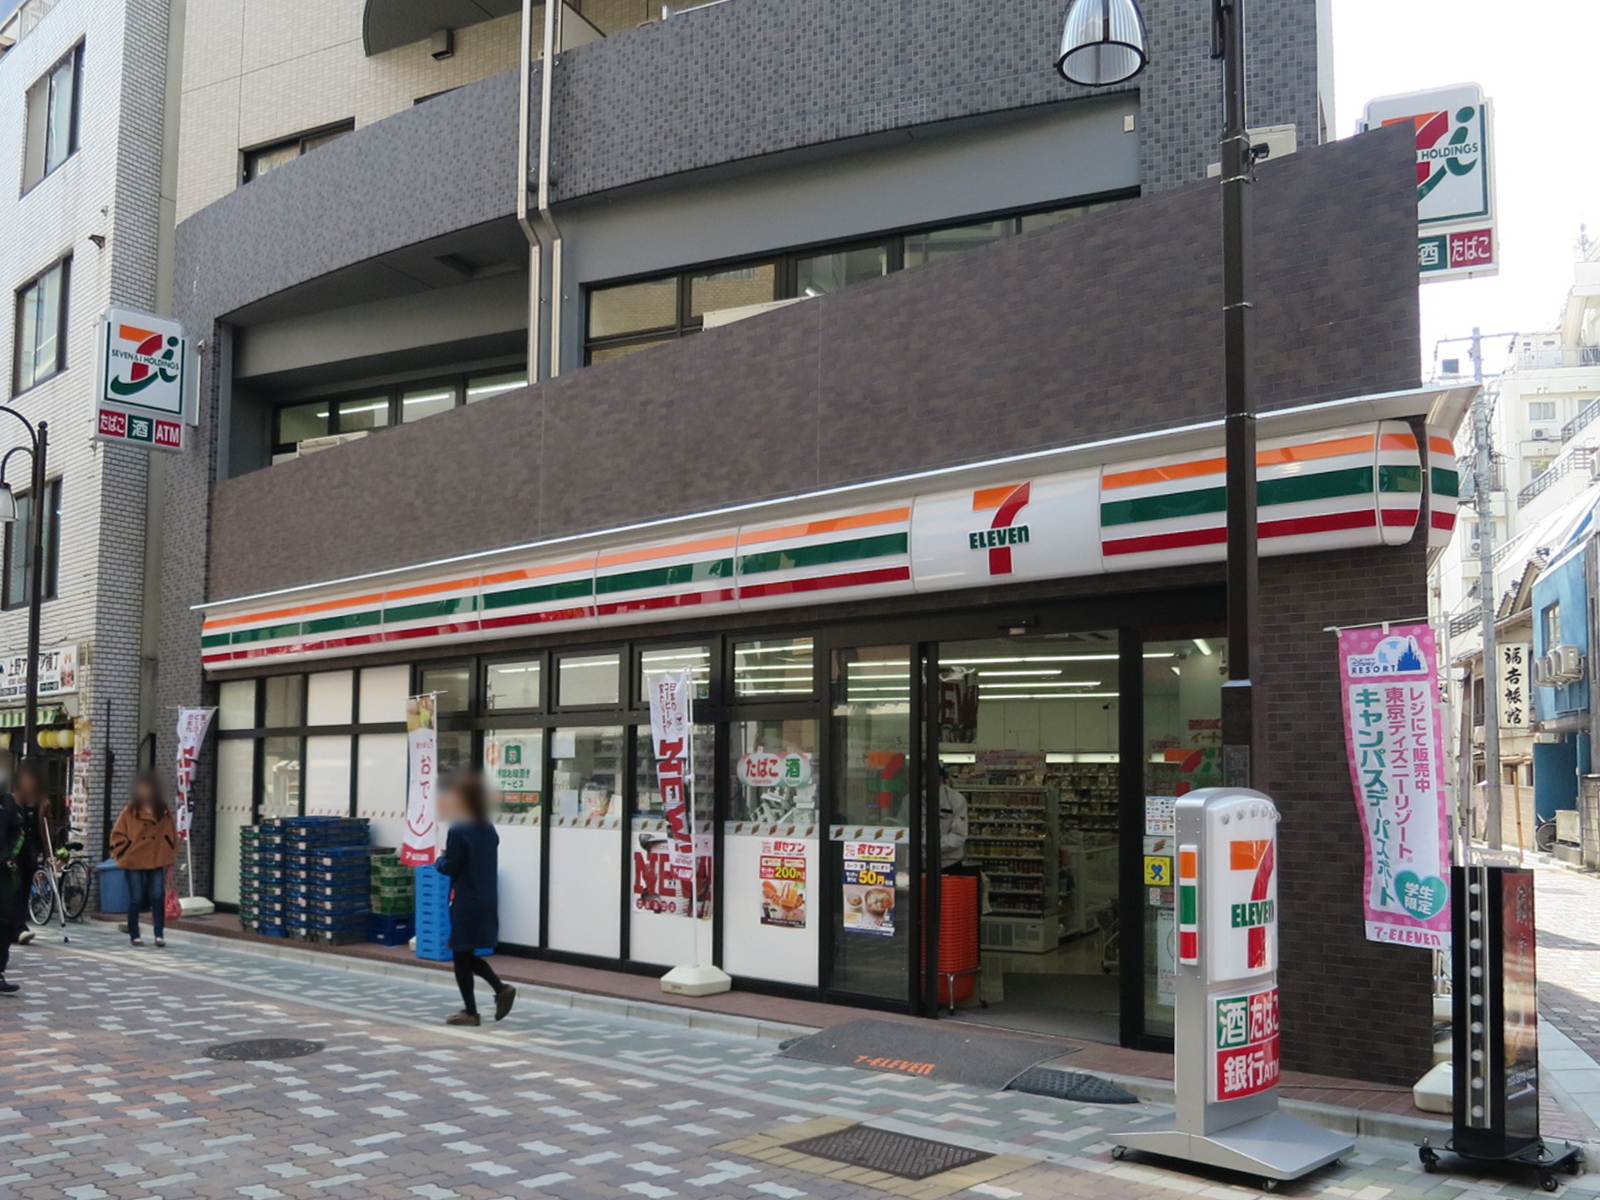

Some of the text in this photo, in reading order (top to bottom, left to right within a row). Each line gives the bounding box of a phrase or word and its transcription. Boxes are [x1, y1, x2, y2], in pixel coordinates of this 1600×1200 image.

[1421, 143, 1478, 160] HOLDINGS
[1452, 236, 1490, 262] たばこ
[143, 356, 179, 370] HOLDINGS
[100, 414, 179, 443] たばこ 酒 ATM
[1351, 665, 1396, 674] RESORT
[1410, 687, 1430, 793] レジにて販売中
[746, 758, 800, 778] たばこ 酒
[1385, 687, 1413, 860] 東京ディズニーリゾート
[1355, 688, 1395, 907] キャンパスデーパスポート
[859, 870, 885, 886] 50円
[1405, 882, 1434, 899] 学生
[1405, 896, 1433, 915] 限定
[1219, 991, 1279, 1046] 酒 たばこ
